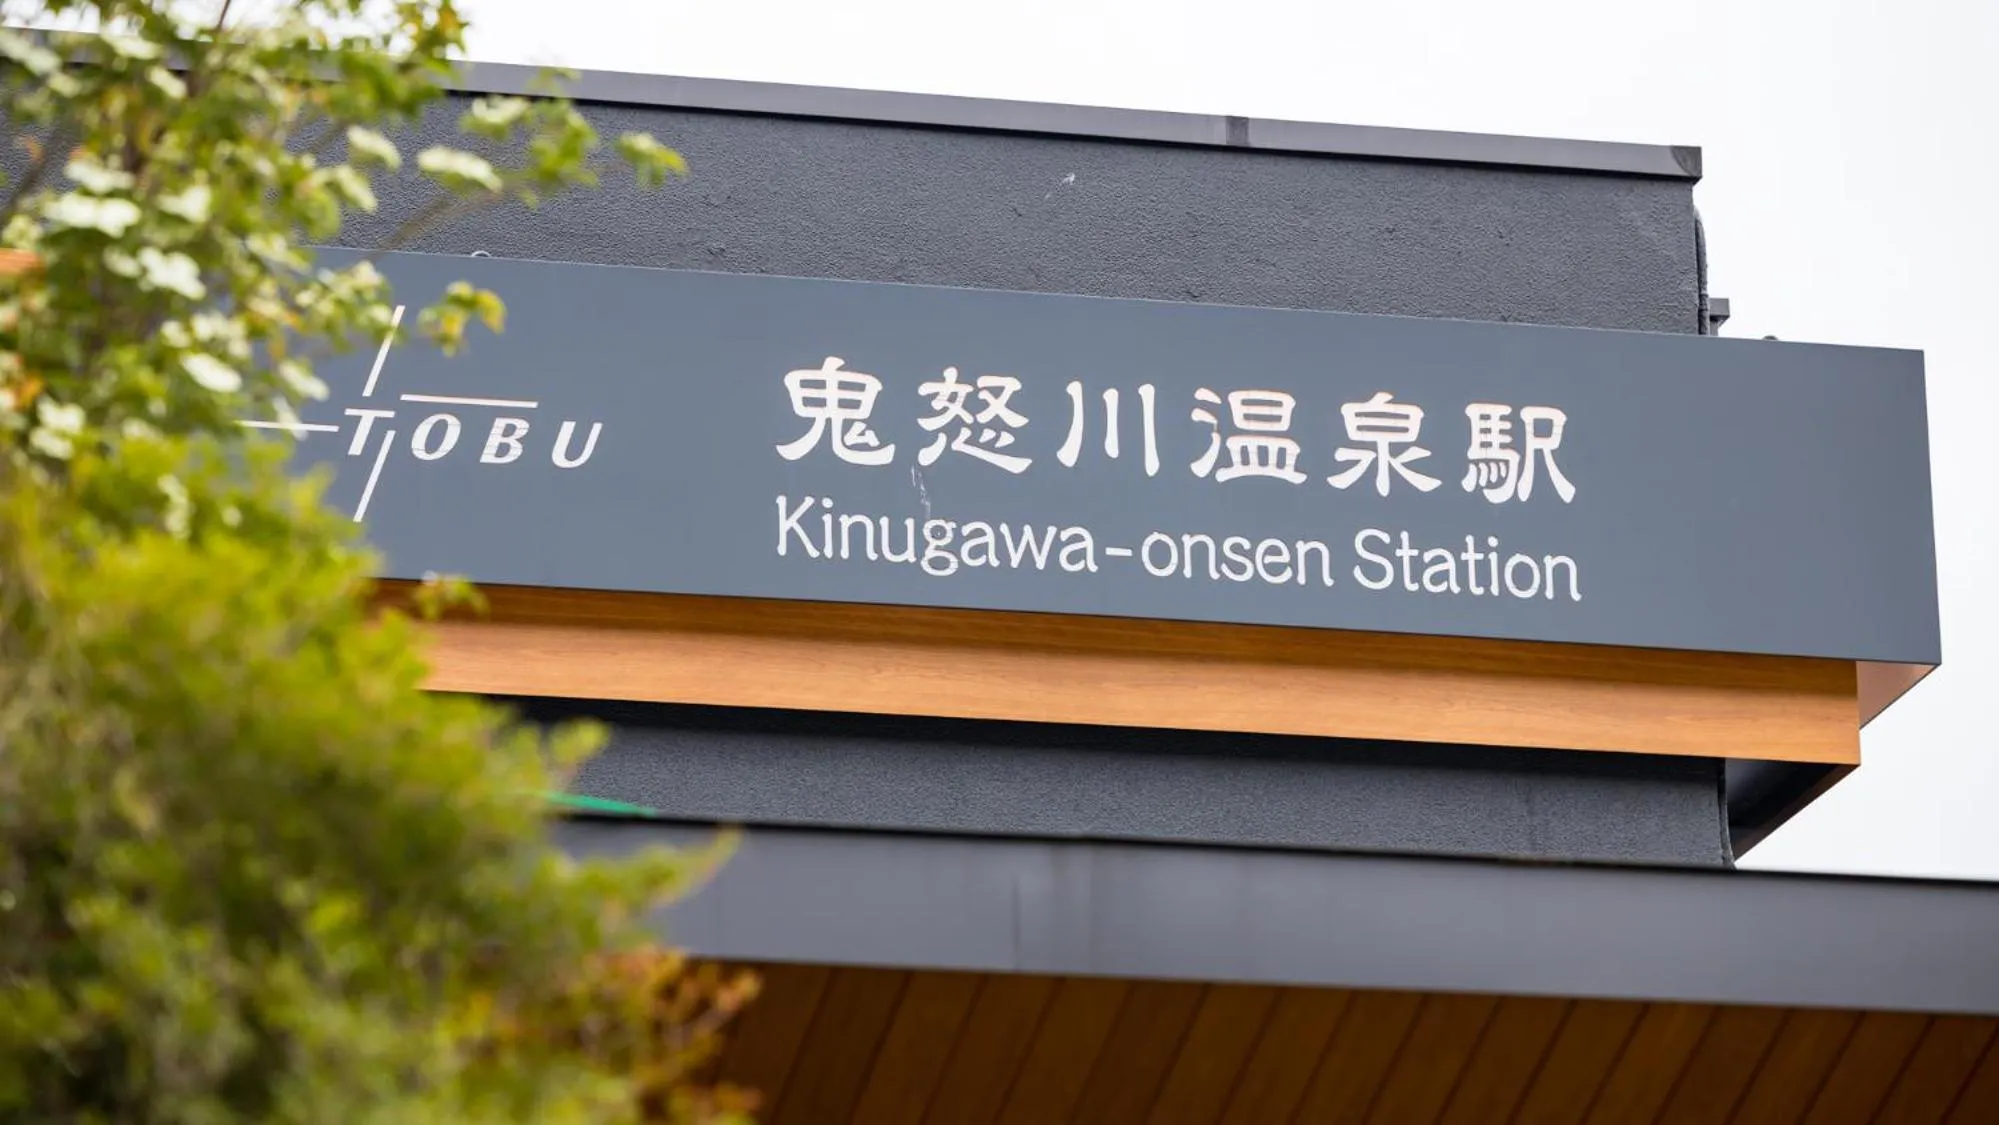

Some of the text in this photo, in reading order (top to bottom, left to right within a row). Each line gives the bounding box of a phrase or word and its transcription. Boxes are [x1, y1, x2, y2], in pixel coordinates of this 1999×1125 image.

[343, 408, 603, 469] TOBU
[776, 356, 1577, 504] 鬼怒川温泉駅
[775, 495, 1582, 602] Kinugawa-onsen Station
